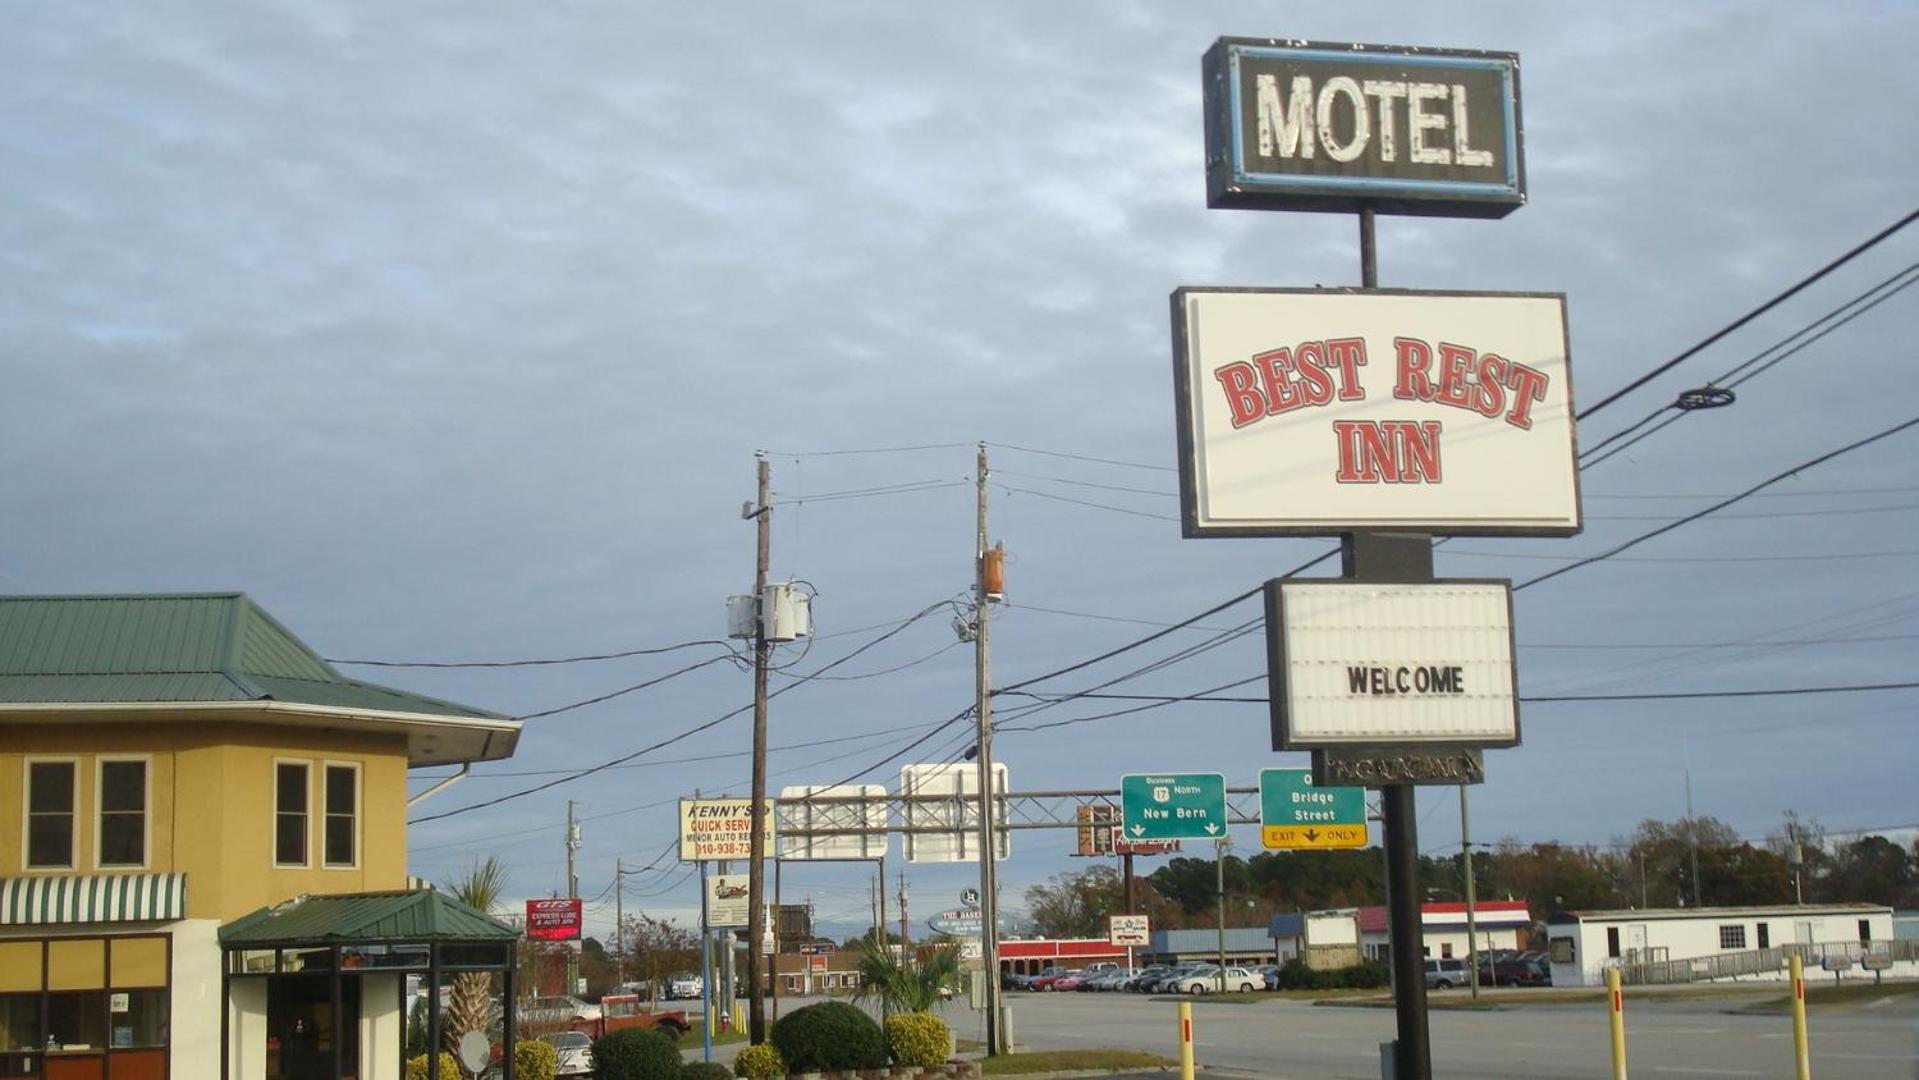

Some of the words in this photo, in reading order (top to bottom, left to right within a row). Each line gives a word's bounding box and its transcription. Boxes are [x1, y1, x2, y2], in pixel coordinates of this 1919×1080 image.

[1256, 74, 1494, 167] MOTEL
[1214, 337, 1367, 429] BEST
[1393, 336, 1549, 430] REST
[1333, 420, 1442, 483] INN
[1347, 666, 1464, 694] WELCOME
[1157, 789, 1166, 799] 17
[1174, 787, 1200, 795] NORTH
[1291, 792, 1334, 804] Bridge
[688, 805, 752, 817] KENNY'S
[1143, 808, 1169, 819] New
[1176, 807, 1207, 819] Bern
[1295, 810, 1335, 820] Street
[690, 820, 721, 832] QUICK
[714, 832, 735, 842] AUTO
[1272, 832, 1295, 840] EXIT
[1327, 831, 1357, 840] ONLY
